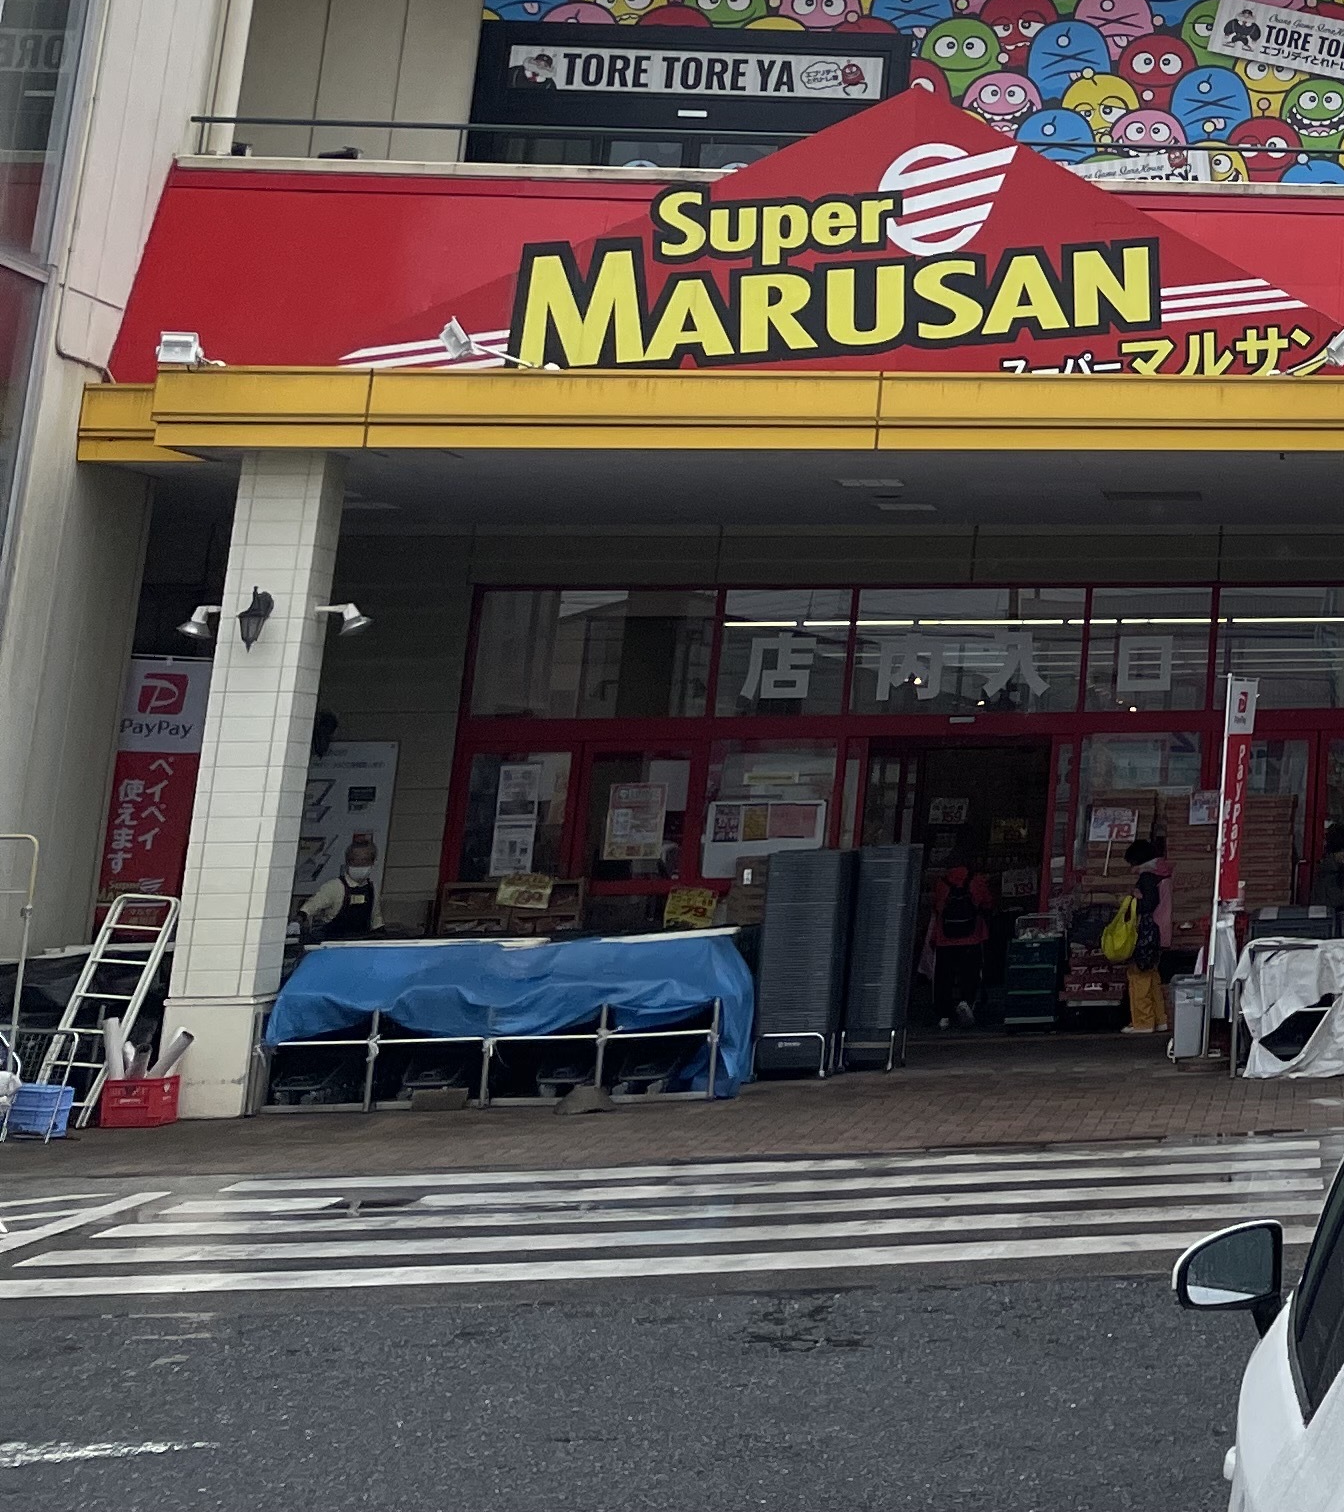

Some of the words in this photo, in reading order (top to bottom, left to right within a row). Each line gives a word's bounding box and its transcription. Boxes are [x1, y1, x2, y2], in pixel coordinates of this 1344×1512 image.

[563, 53, 652, 88] TORE
[662, 56, 749, 92] TORE
[756, 59, 796, 93] YA
[1265, 25, 1315, 52] TORE
[656, 190, 893, 266] Super
[515, 245, 1151, 370] MARUSAN
[119, 718, 194, 739] PayPay
[107, 778, 147, 875] 使えます
[137, 756, 175, 850] ペイペイ
[1229, 744, 1246, 862] PayPay
